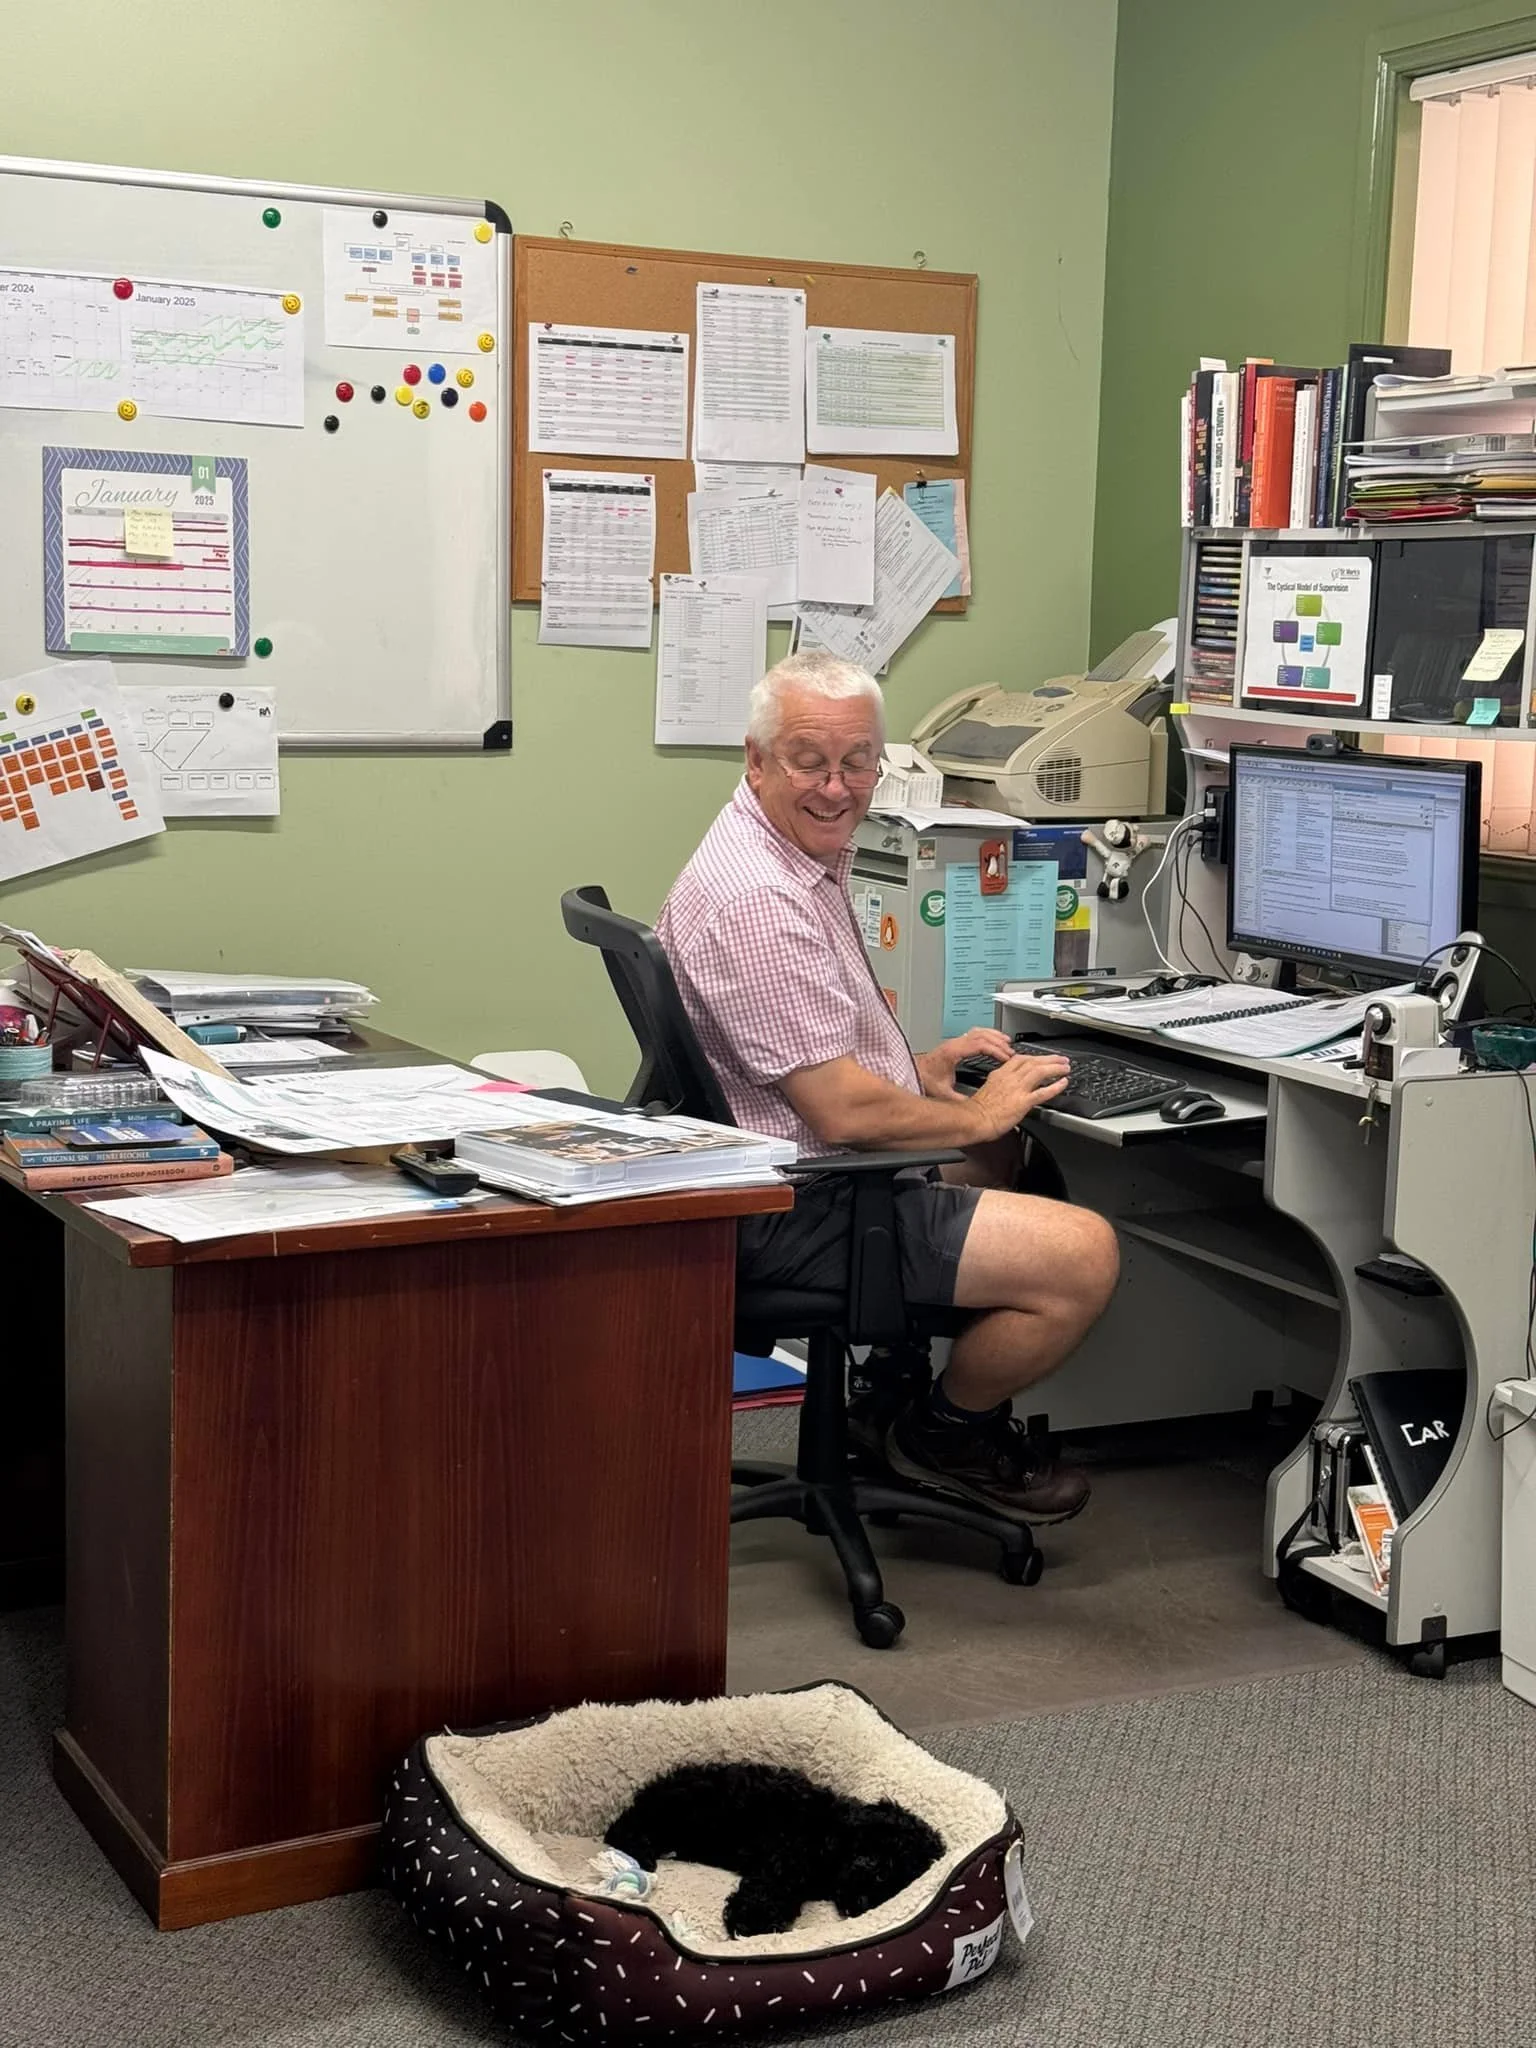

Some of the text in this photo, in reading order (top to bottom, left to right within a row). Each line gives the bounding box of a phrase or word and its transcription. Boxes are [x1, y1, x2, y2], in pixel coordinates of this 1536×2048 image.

[12, 283, 35, 293] 2024
[135, 293, 196, 307] January 2025
[198, 466, 209, 480] 01
[75, 478, 180, 508] January
[194, 495, 214, 506] 2025
[1267, 582, 1276, 591] The
[1297, 583, 1312, 591] Model
[1313, 583, 1319, 592] of
[1319, 584, 1349, 592] Supervision
[35, 1118, 71, 1128] PRAYING
[72, 1117, 90, 1126] LIFE
[42, 1154, 89, 1164] ORIGINAL SIN
[72, 1168, 186, 1183] THE GROWTH GROUP NOTEBOOK
[1400, 1420, 1450, 1447] CAR
[963, 1950, 988, 1978] Pet
